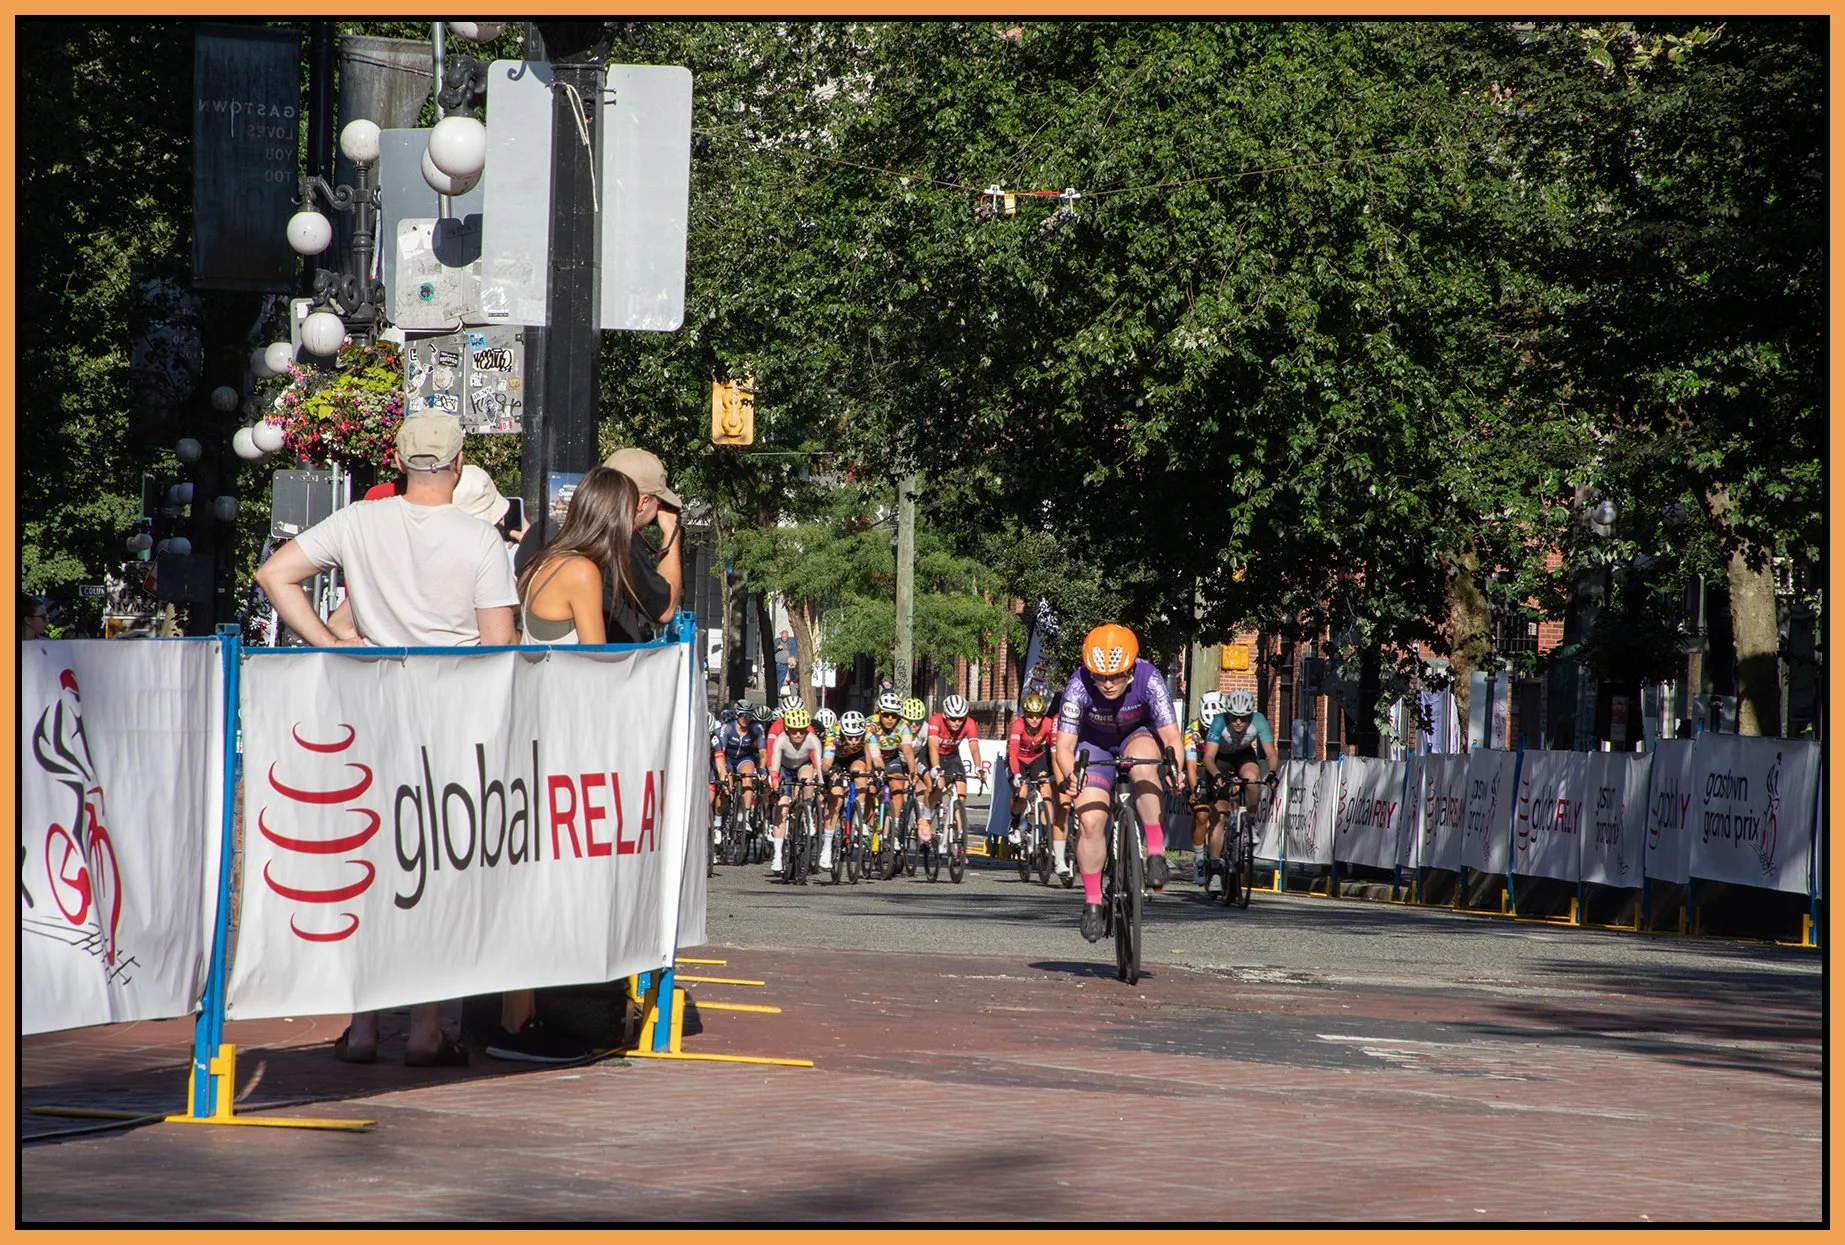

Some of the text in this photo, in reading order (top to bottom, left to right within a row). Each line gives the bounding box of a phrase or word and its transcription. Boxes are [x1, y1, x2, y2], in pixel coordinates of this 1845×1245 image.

[1063, 703, 1081, 714] VELO
[394, 739, 541, 910] global
[1702, 805, 1732, 844] grand
[1735, 810, 1760, 848] prix
